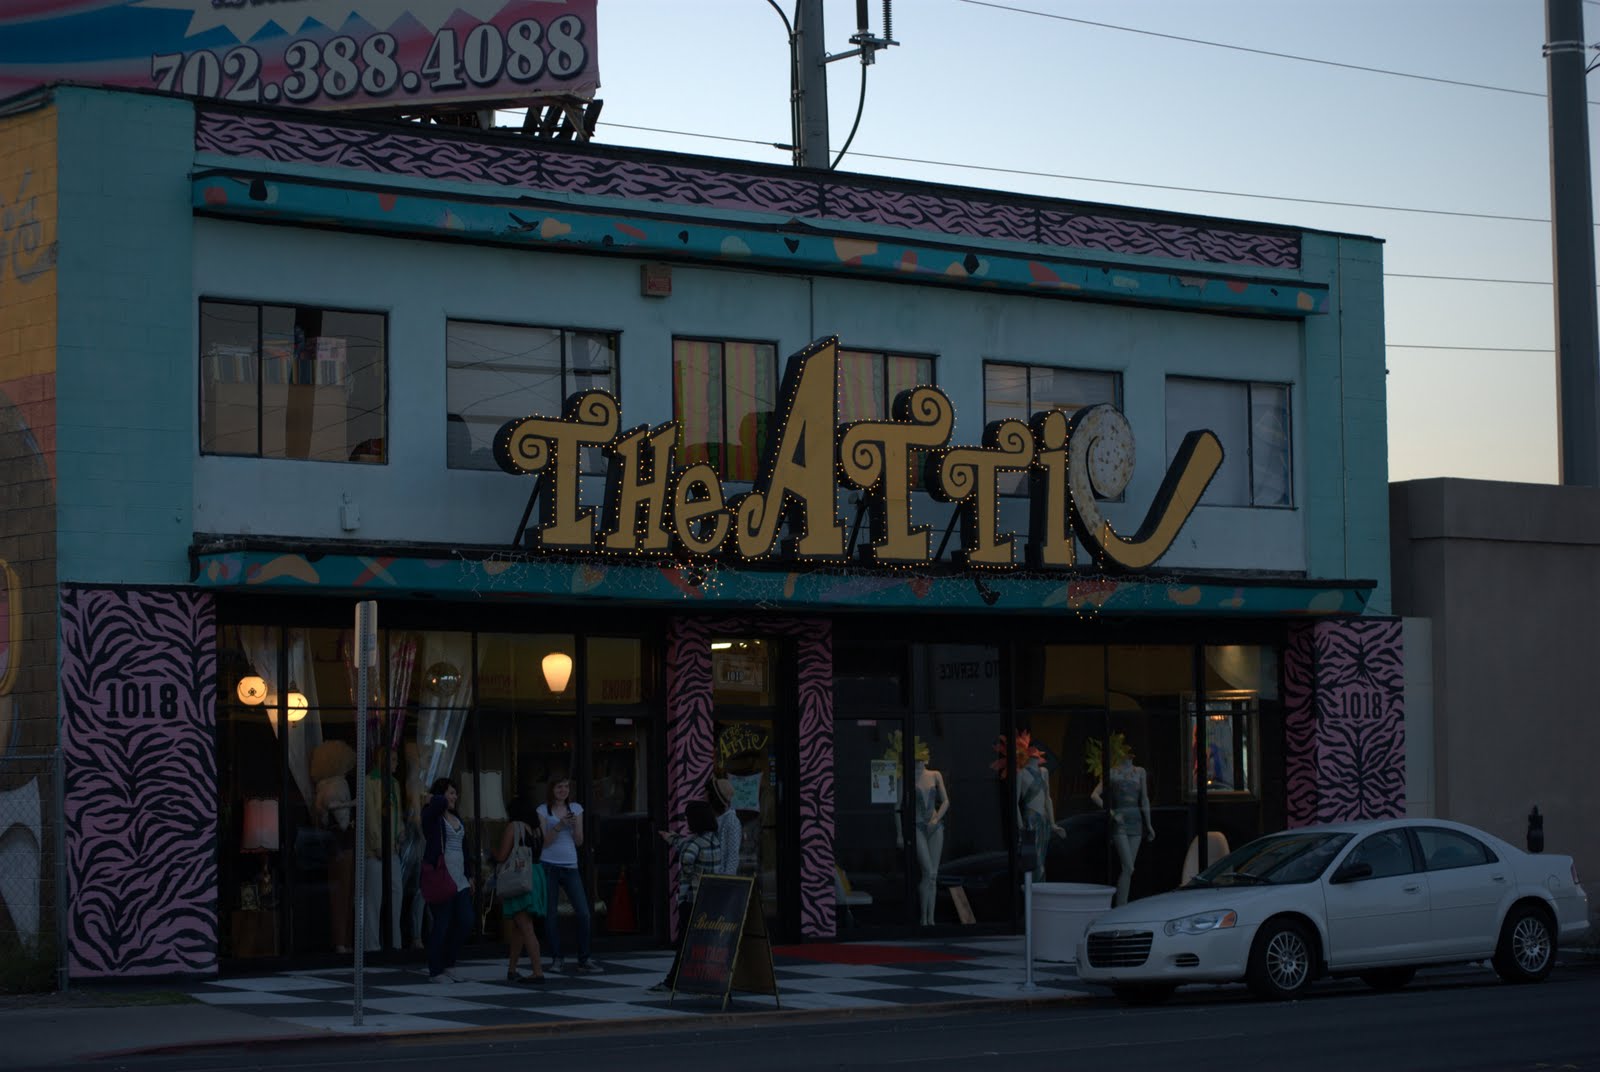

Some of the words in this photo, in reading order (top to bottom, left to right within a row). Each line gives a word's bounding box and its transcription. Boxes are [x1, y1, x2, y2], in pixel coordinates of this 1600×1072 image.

[151, 13, 589, 104] 702.388.4088
[106, 682, 178, 719] 1018
[1340, 691, 1383, 720] 1018
